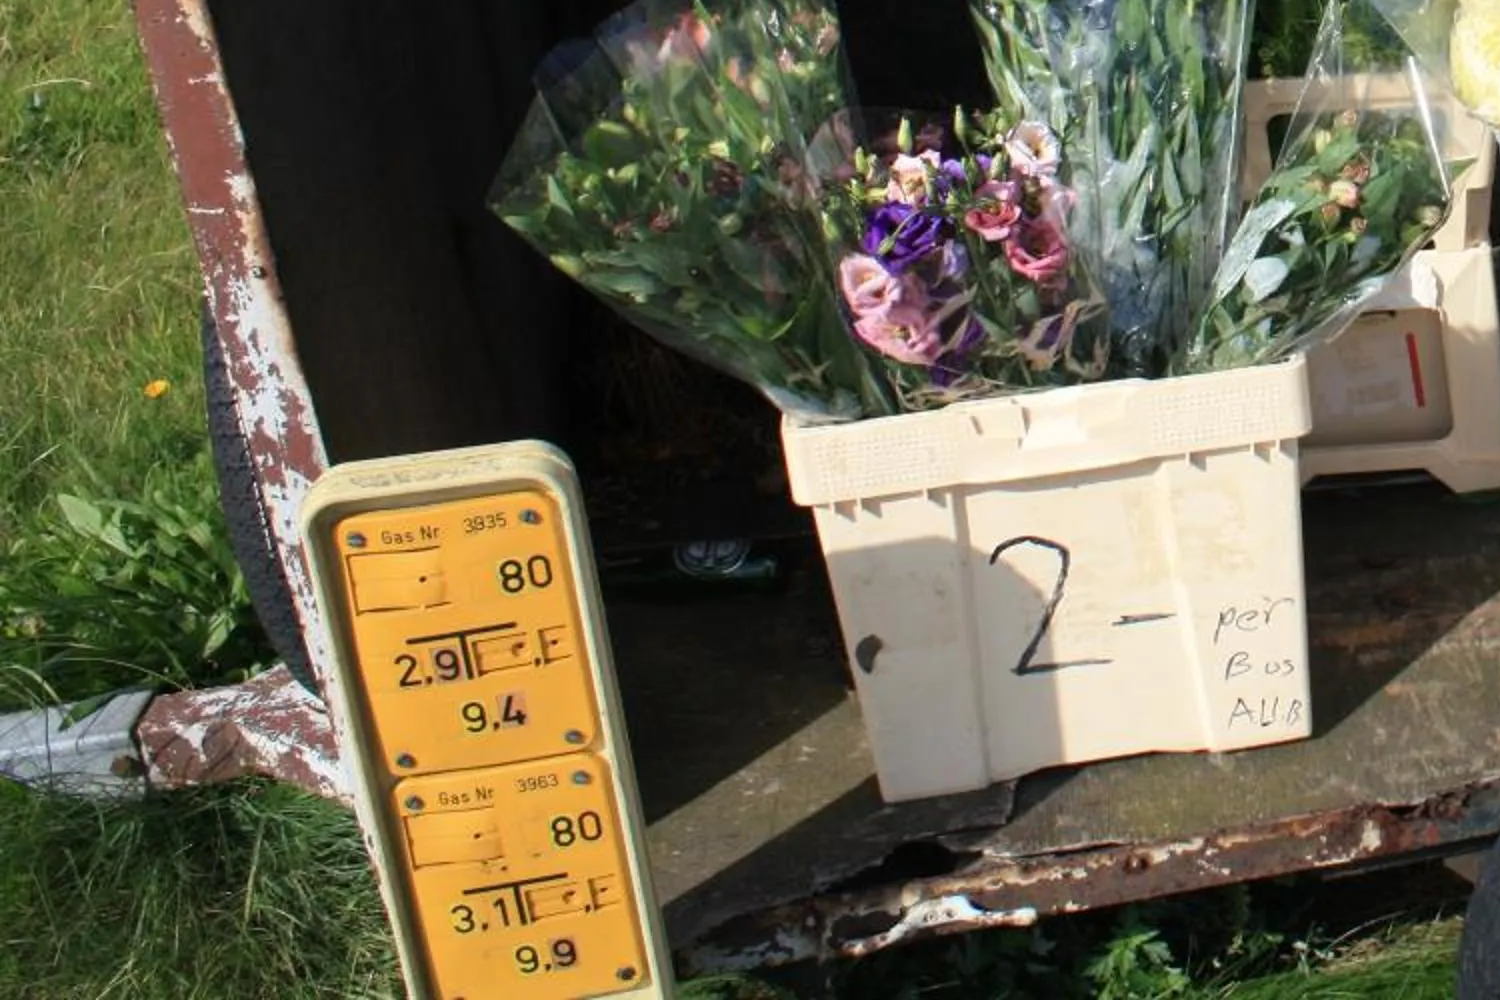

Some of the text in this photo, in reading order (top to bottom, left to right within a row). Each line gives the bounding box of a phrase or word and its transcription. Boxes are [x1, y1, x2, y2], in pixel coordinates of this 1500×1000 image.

[381, 530, 415, 545] Gas
[419, 525, 440, 541] Nr
[499, 555, 552, 593] 80
[438, 790, 470, 806] Gas
[475, 786, 494, 801] Nr
[551, 810, 603, 847] 80
